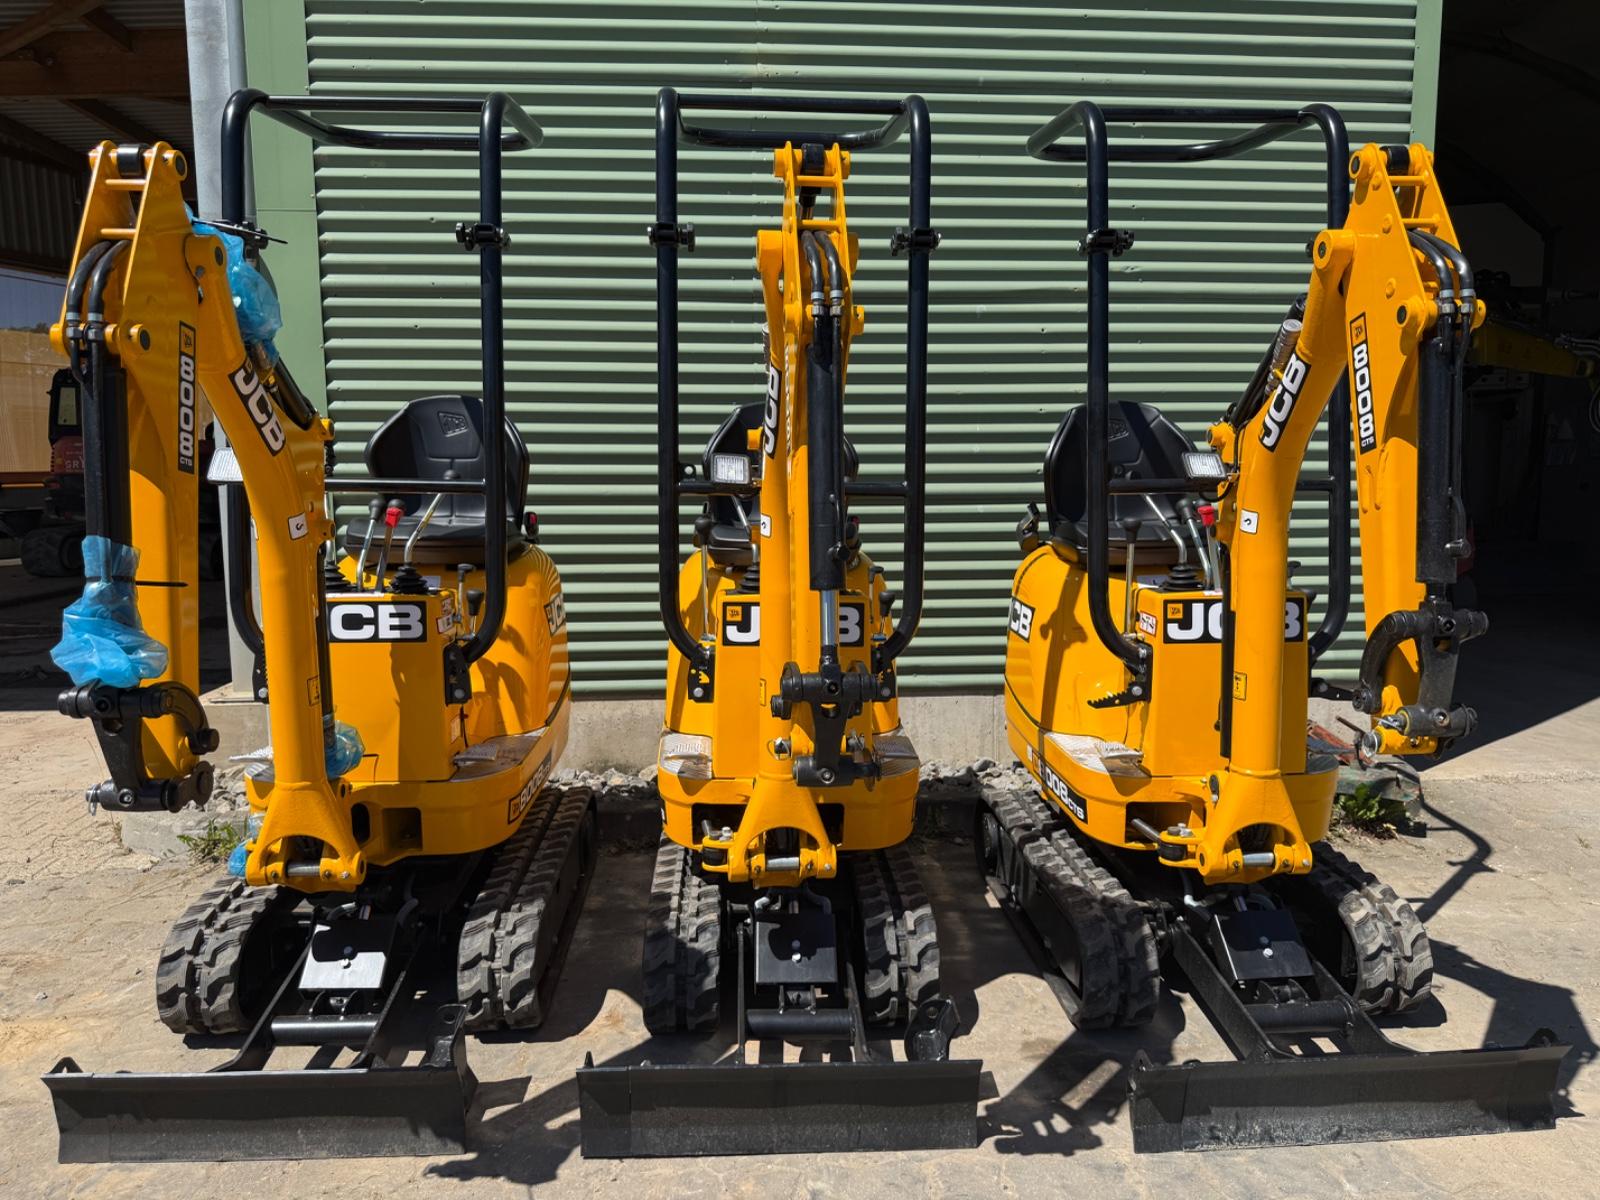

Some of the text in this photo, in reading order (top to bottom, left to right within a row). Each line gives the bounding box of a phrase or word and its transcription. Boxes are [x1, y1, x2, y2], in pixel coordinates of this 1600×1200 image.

[234, 368, 286, 451] JCB
[764, 362, 780, 454] JCB
[1262, 352, 1306, 447] JCB
[330, 604, 424, 640] CB
[726, 605, 861, 643] JB
[1009, 599, 1033, 639] CB
